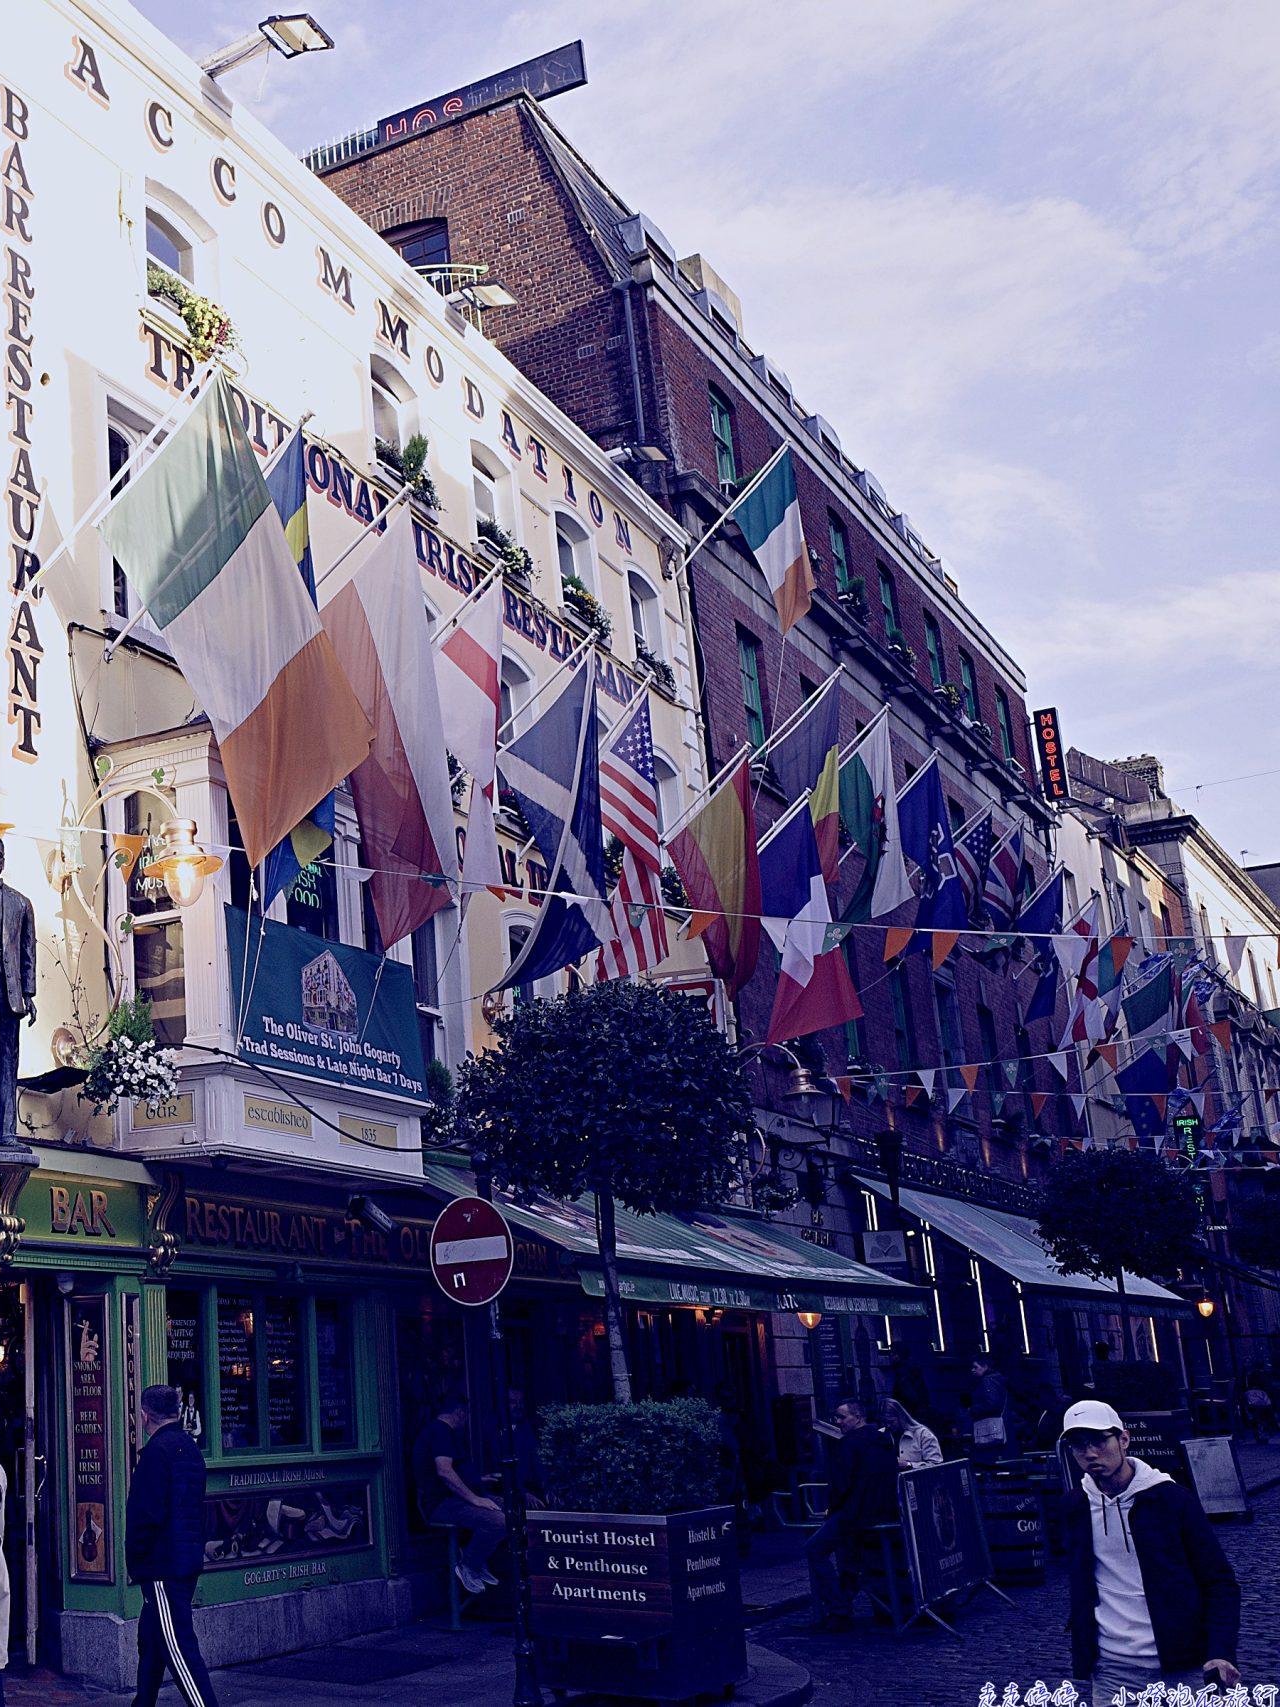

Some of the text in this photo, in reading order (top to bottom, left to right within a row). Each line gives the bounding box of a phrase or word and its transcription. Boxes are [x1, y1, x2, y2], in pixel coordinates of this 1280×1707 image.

[65, 35, 632, 555] ACCOMMODATION
[3, 244, 44, 764] RESTAURANT
[1040, 713, 1063, 795] HOSTEL
[262, 1015, 401, 1069] The Oliver St. John Gogarty
[243, 1036, 422, 1094] Trad Sessions & Late Night Bar 7 Days
[248, 1105, 308, 1130] established
[361, 1127, 377, 1142] 1835
[1177, 1118, 1198, 1127] IRISH
[49, 1187, 116, 1237] BAR
[185, 1197, 327, 1257] RESTAURANT
[74, 1360, 101, 1371] SMOKING
[80, 1374, 96, 1384] AREA
[127, 1325, 136, 1444] SMOKING
[83, 1386, 102, 1396] FLOOR
[80, 1411, 98, 1422] BEER
[75, 1424, 102, 1434] GARDEN
[80, 1449, 98, 1460] LIVE
[1147, 1448, 1176, 1456] Music
[79, 1462, 101, 1472] IRISH
[77, 1474, 103, 1485] MUSIC
[229, 1472, 279, 1486] TRADITIONAL
[283, 1469, 300, 1482] IRISH
[541, 1529, 655, 1547] Tourist Hostel
[688, 1526, 716, 1544] Hostel &
[548, 1556, 648, 1575] & Penthouse
[686, 1554, 721, 1572] Penthouse
[244, 1562, 326, 1585] GOGARTY'S IRISH BAR
[552, 1583, 647, 1602] Apartments
[686, 1580, 726, 1601] Apartments
